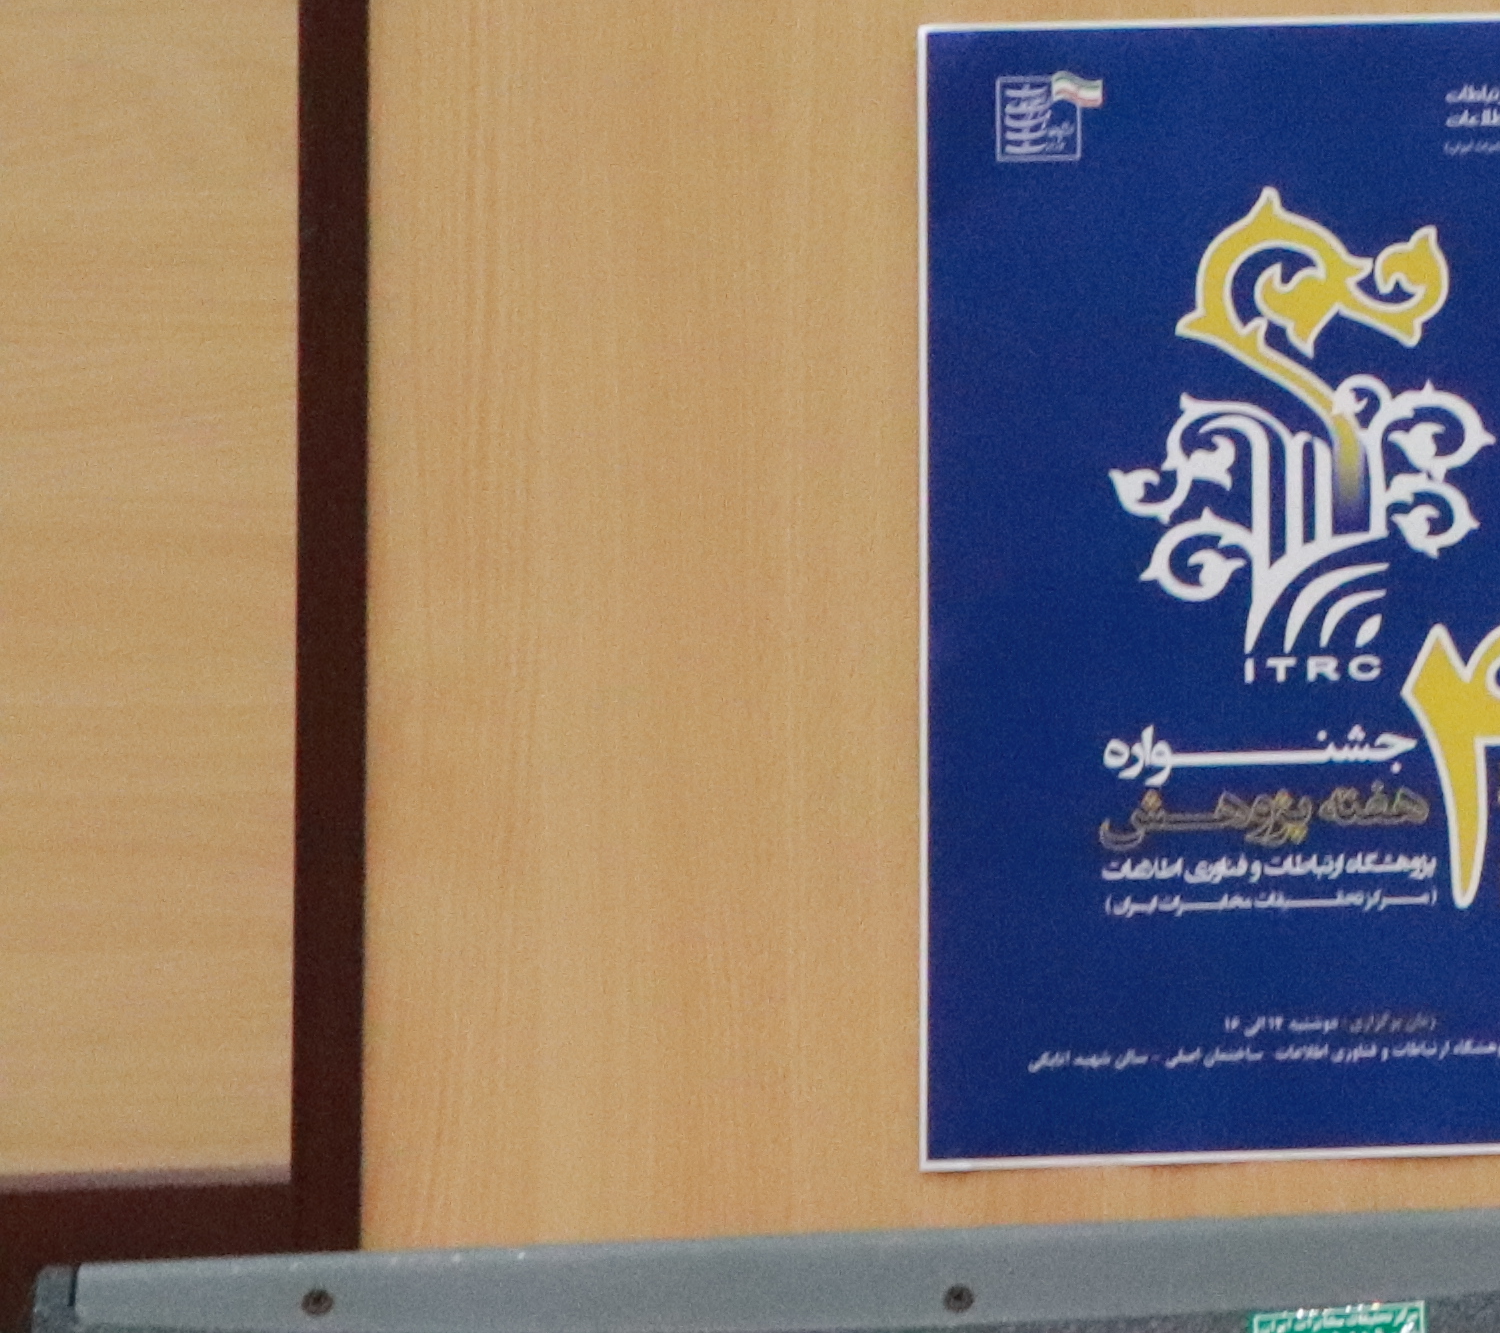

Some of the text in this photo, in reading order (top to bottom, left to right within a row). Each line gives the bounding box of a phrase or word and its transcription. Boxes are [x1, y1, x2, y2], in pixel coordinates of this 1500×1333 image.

[1244, 656, 1384, 684] ITRC
[1103, 724, 1418, 787] جشنواره
[1100, 779, 1430, 851] هفته پژوهش
[1101, 851, 1437, 883] پژوهشگاه ارتباطات و فناوری اطلاعات
